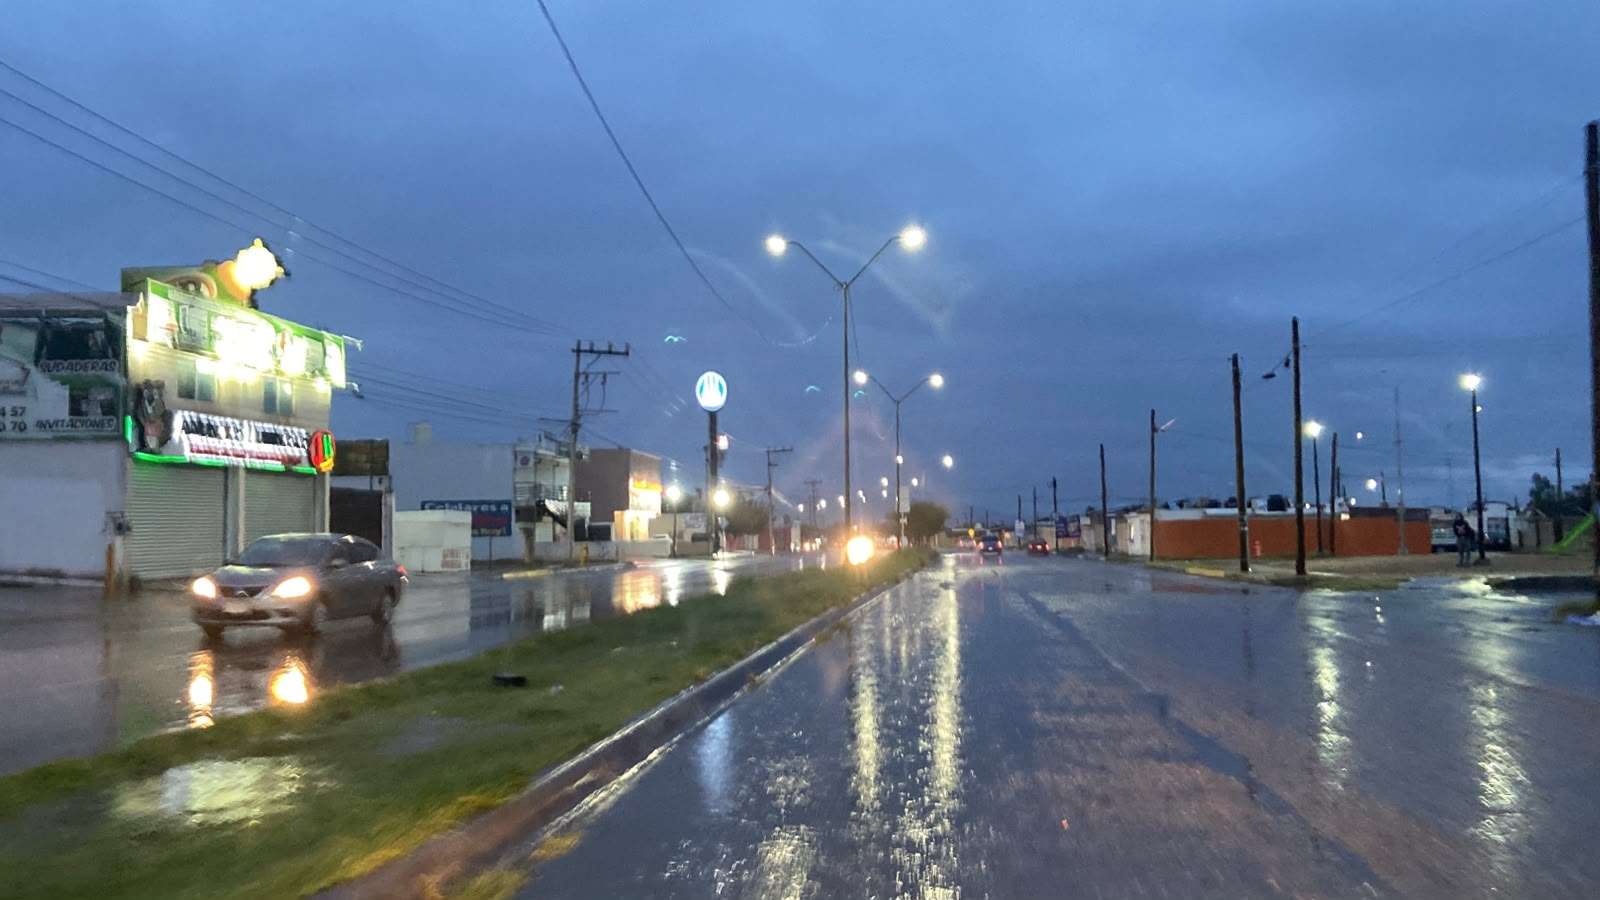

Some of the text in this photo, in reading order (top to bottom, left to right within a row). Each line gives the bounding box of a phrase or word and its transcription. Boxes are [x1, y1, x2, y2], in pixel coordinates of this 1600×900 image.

[40, 360, 117, 372] SUDADERAS
[11, 406, 27, 417] 57
[10, 420, 27, 432] 70
[36, 417, 115, 428] INVITACIONES
